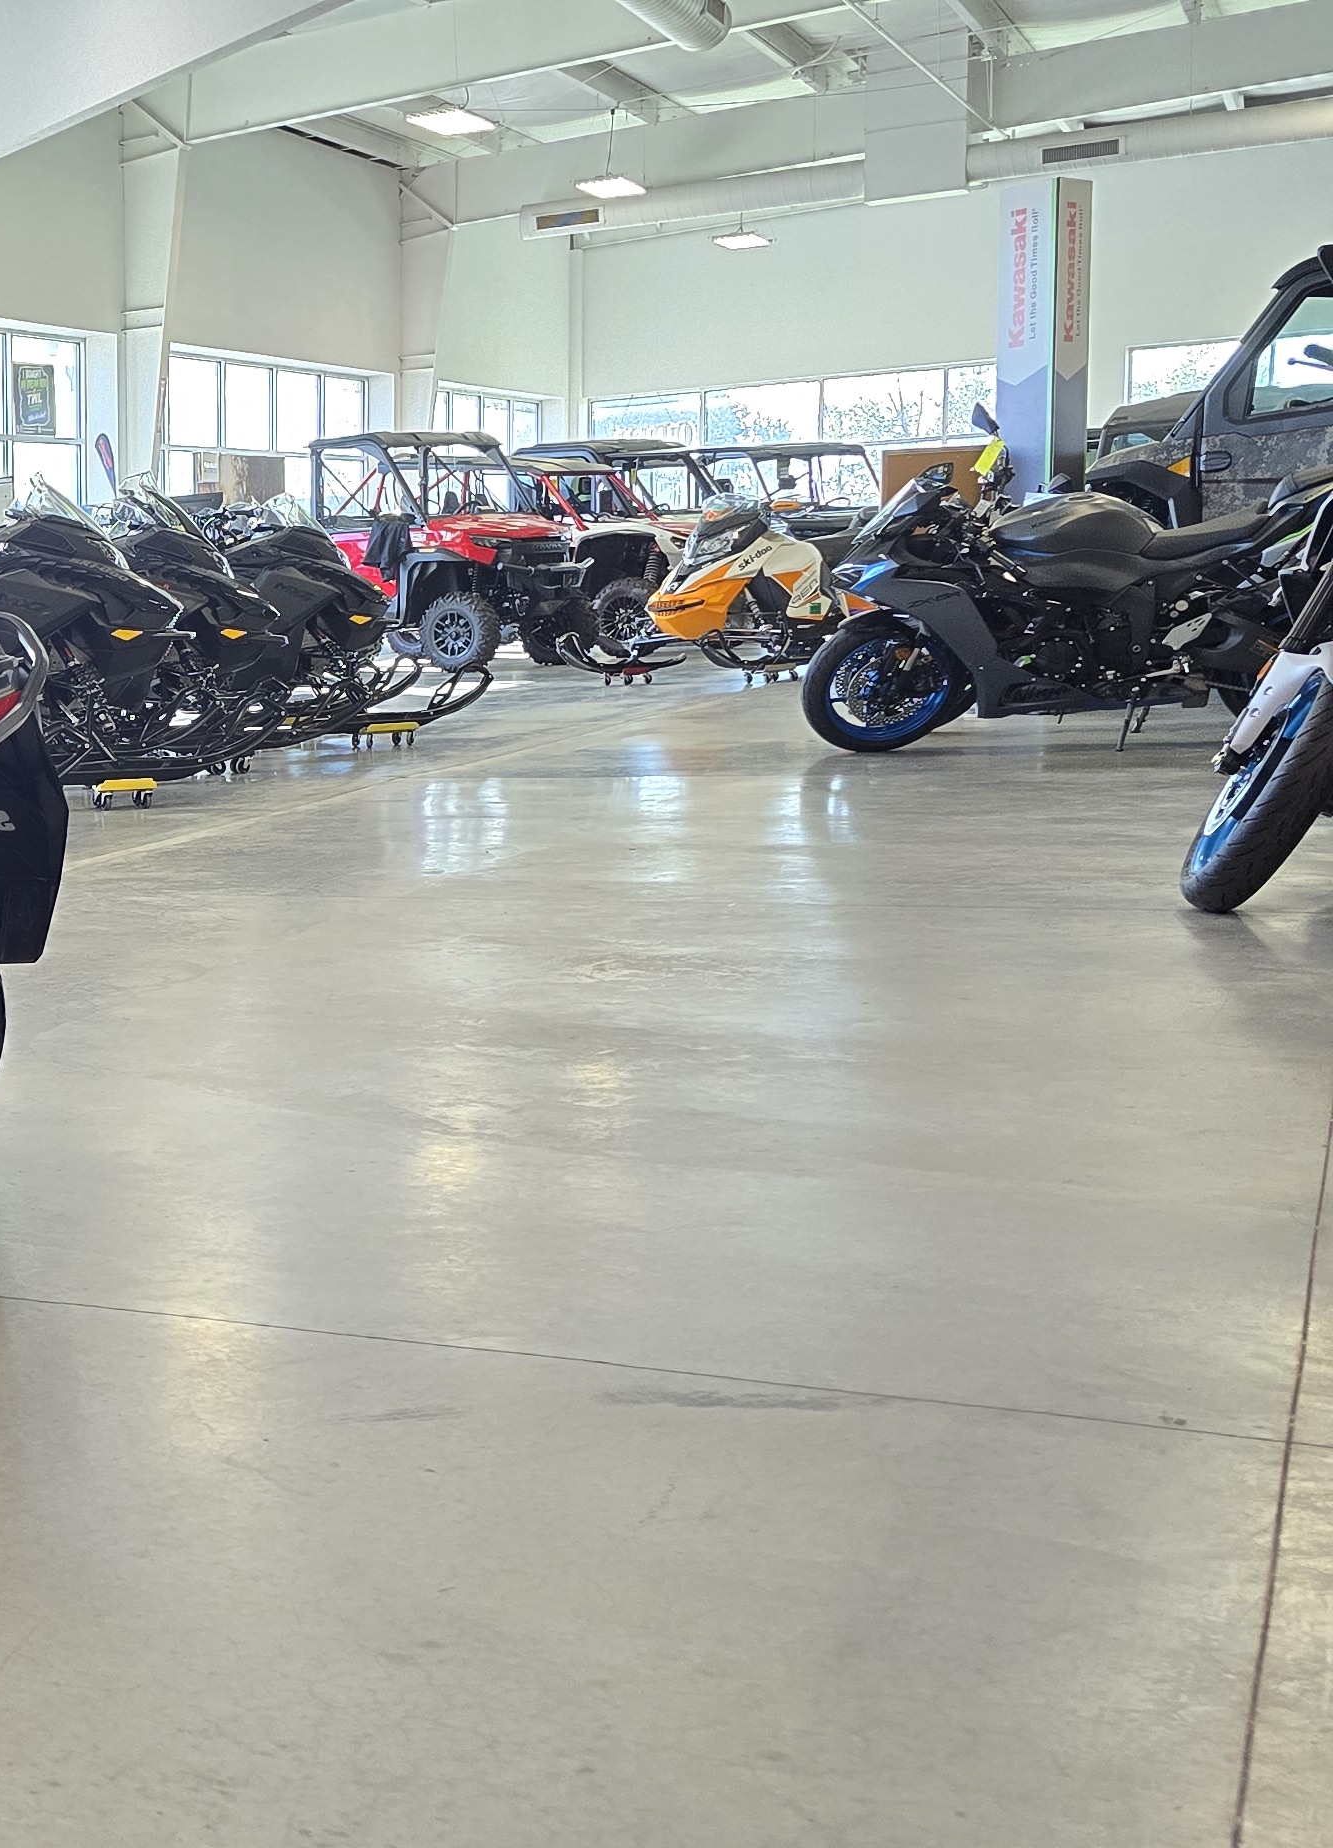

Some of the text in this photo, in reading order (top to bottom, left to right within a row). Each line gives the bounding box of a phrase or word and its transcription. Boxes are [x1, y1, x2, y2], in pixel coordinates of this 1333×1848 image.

[1030, 234, 1038, 267] Times
[1008, 207, 1028, 349] Kawasaki
[1029, 269, 1038, 300] Good
[1063, 201, 1078, 343] Kawasaki
[1029, 301, 1038, 319] the
[1029, 319, 1037, 340] Let
